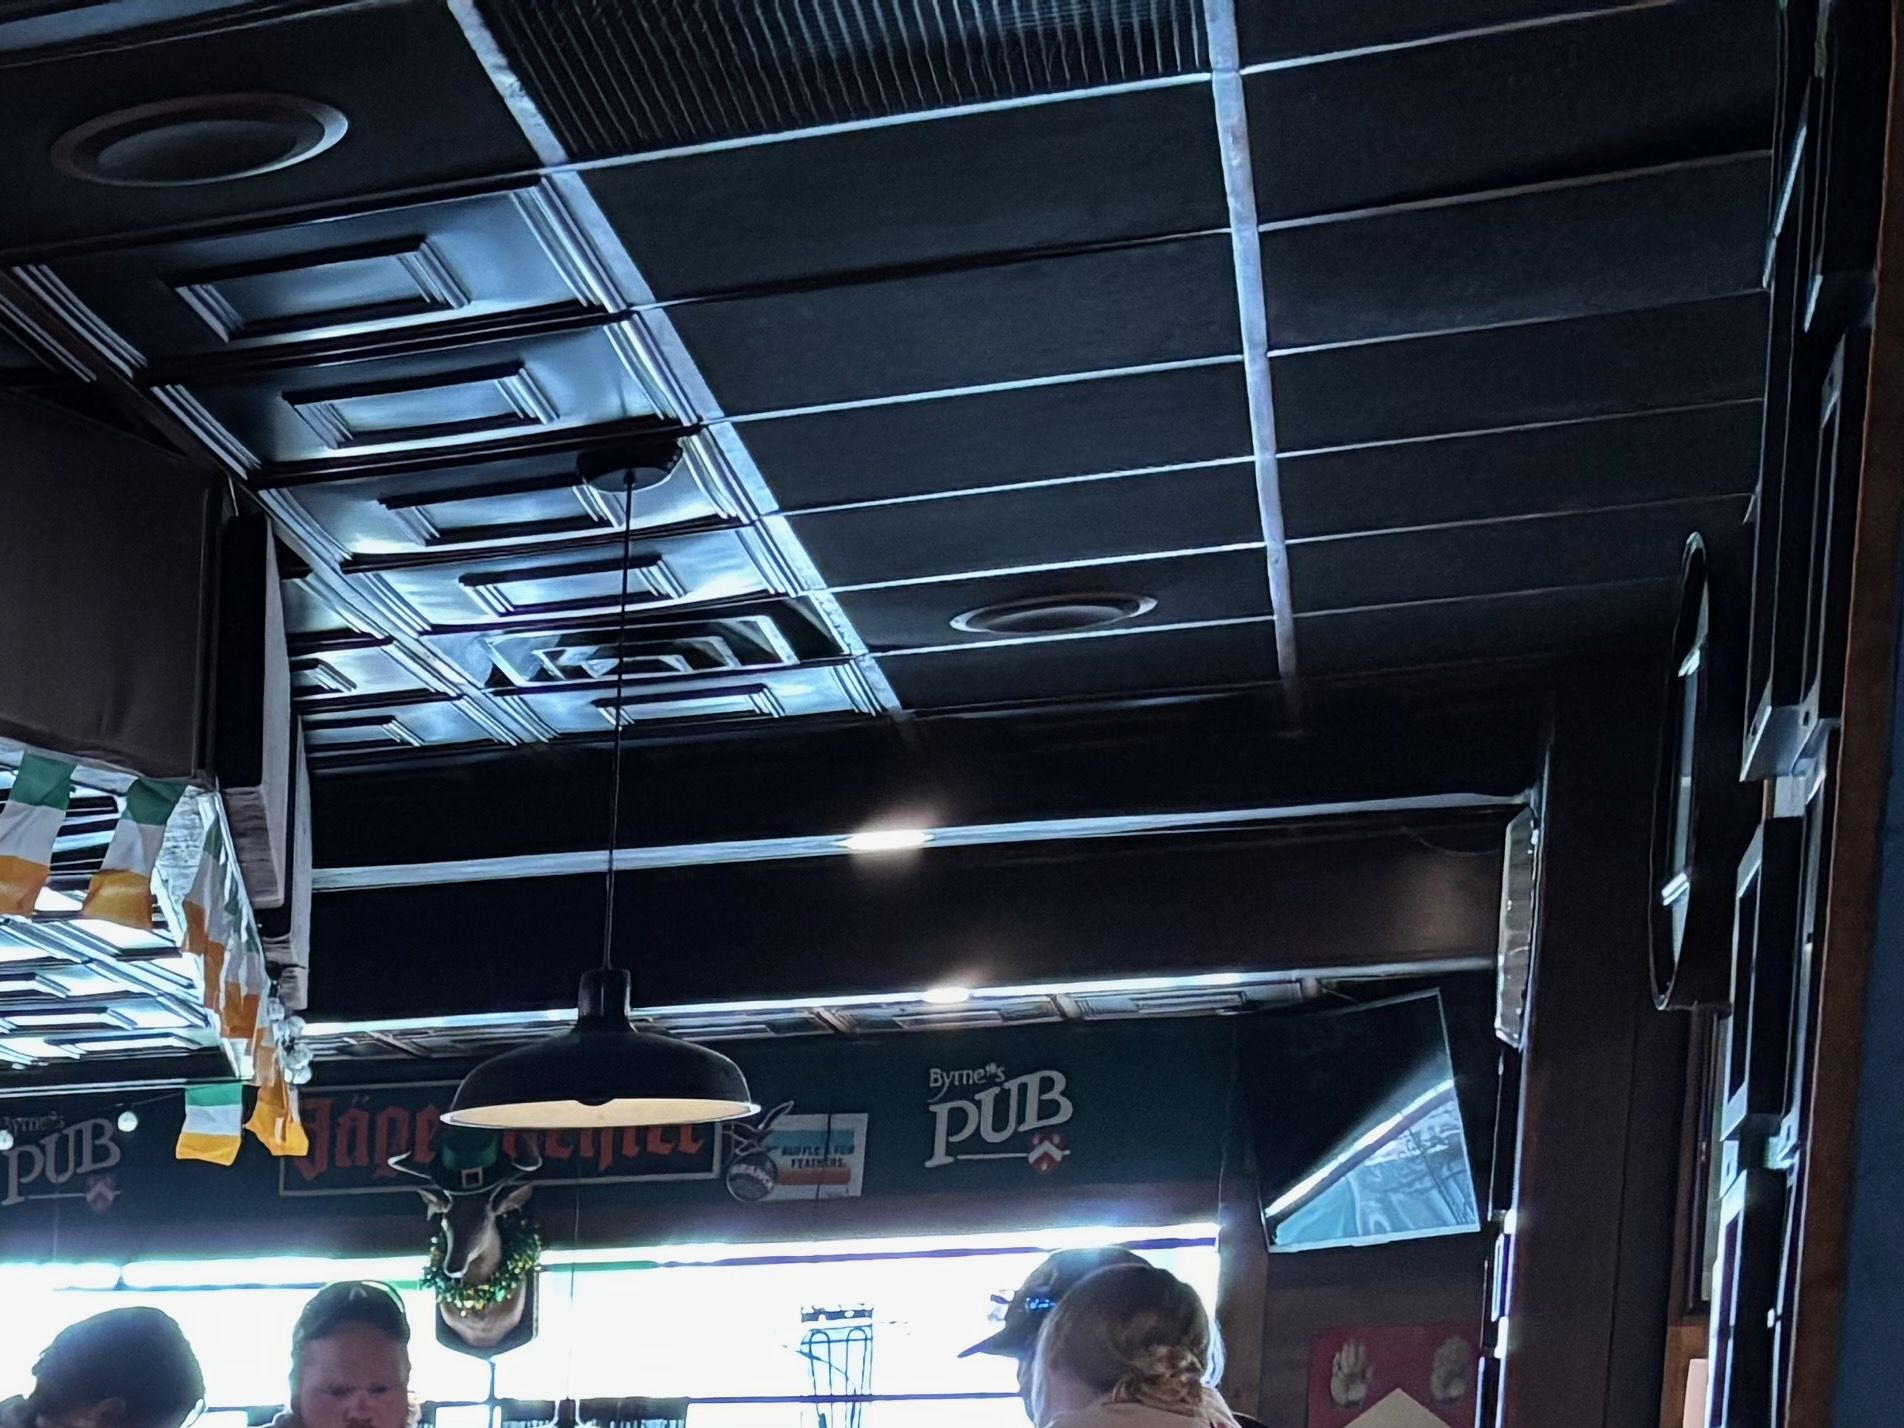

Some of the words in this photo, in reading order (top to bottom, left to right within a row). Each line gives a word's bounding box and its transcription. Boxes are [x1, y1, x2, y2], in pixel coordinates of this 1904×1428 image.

[924, 1069, 1074, 1168] PUB
[927, 1062, 1007, 1103] Byrne's
[1, 1118, 121, 1207] PUB
